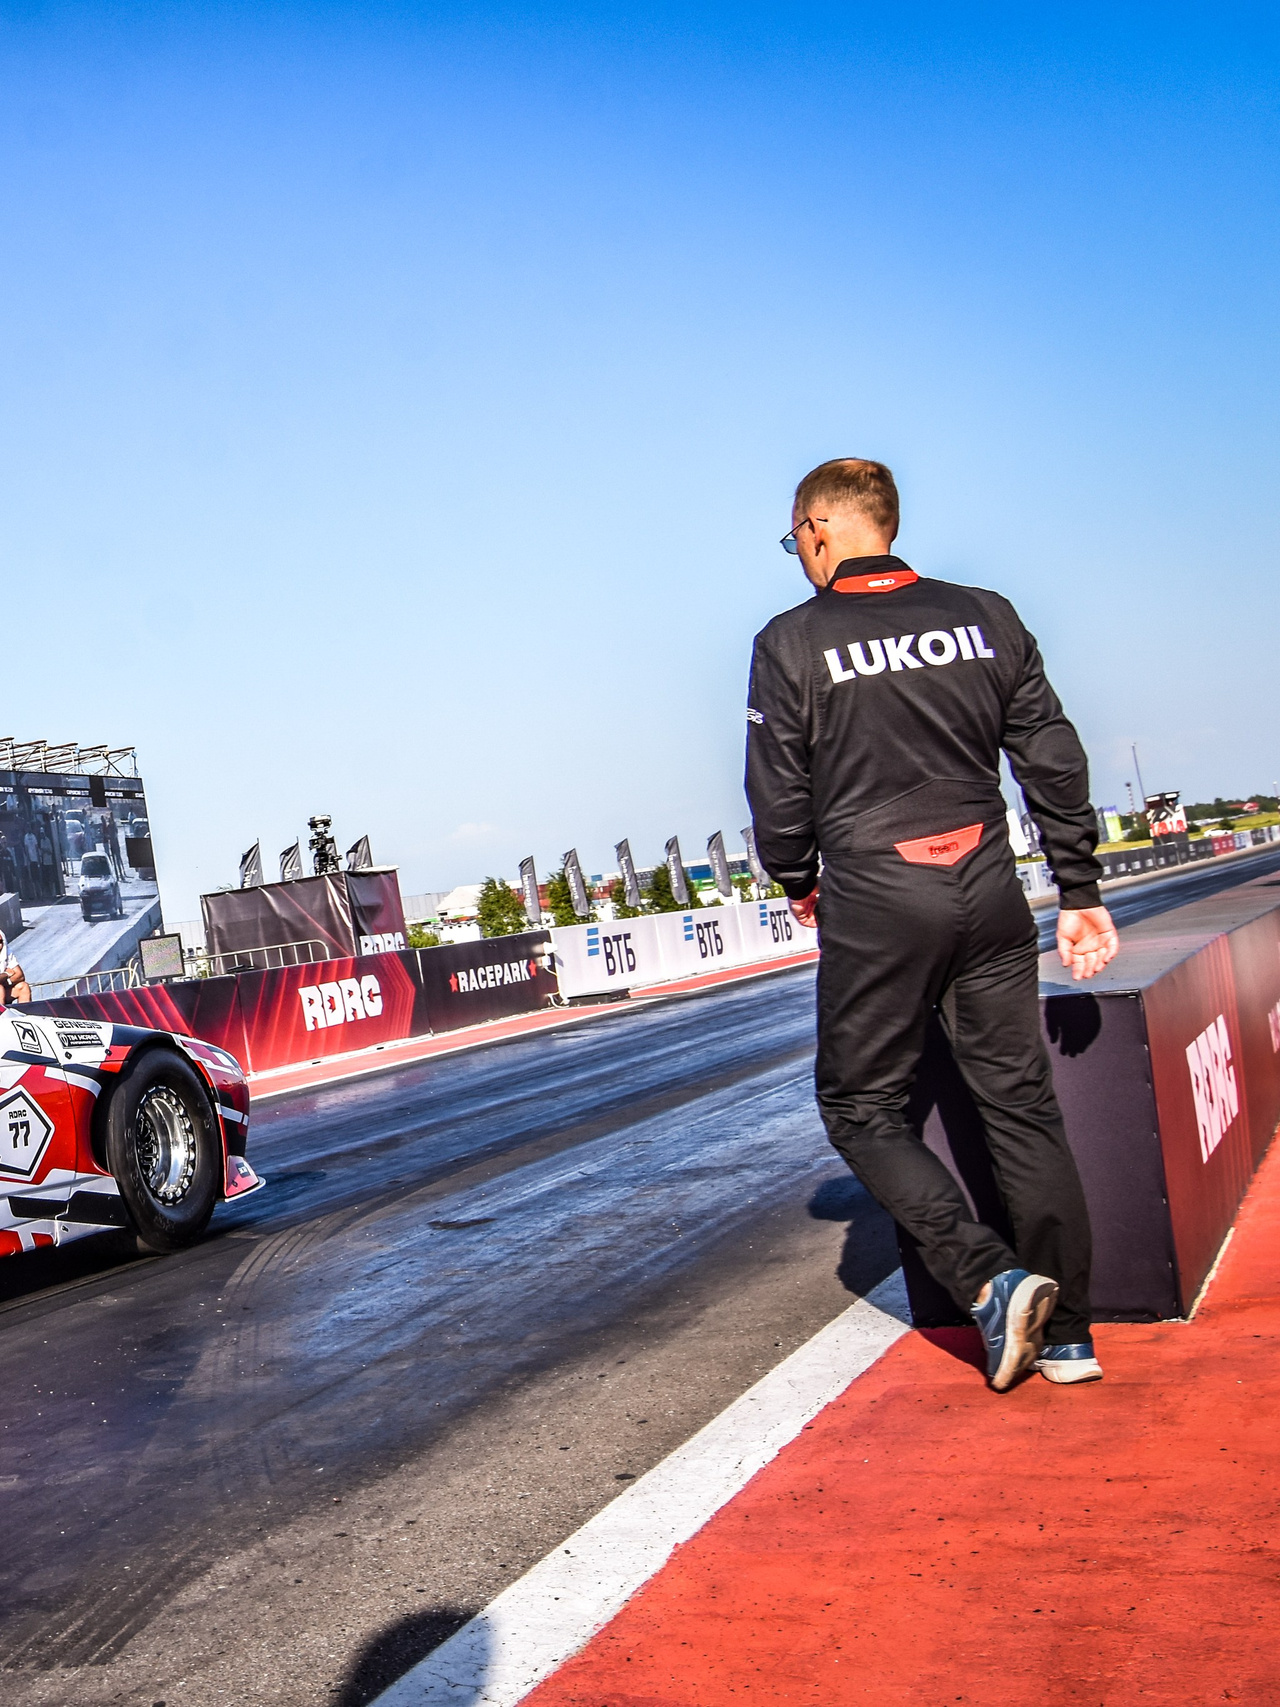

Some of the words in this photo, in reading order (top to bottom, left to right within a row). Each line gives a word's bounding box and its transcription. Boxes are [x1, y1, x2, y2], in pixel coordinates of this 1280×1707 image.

[823, 625, 995, 684] LUKOIL
[695, 920, 724, 959] ВТБ
[769, 909, 793, 943] ВТБ
[602, 932, 636, 976] ВТБ
[457, 960, 531, 993] RACEPARK
[298, 974, 383, 1032] RDRC
[53, 1020, 103, 1029] GENESIS
[1185, 1013, 1239, 1164] RDRC
[9, 1109, 27, 1119] RDRC
[9, 1120, 30, 1149] 77
